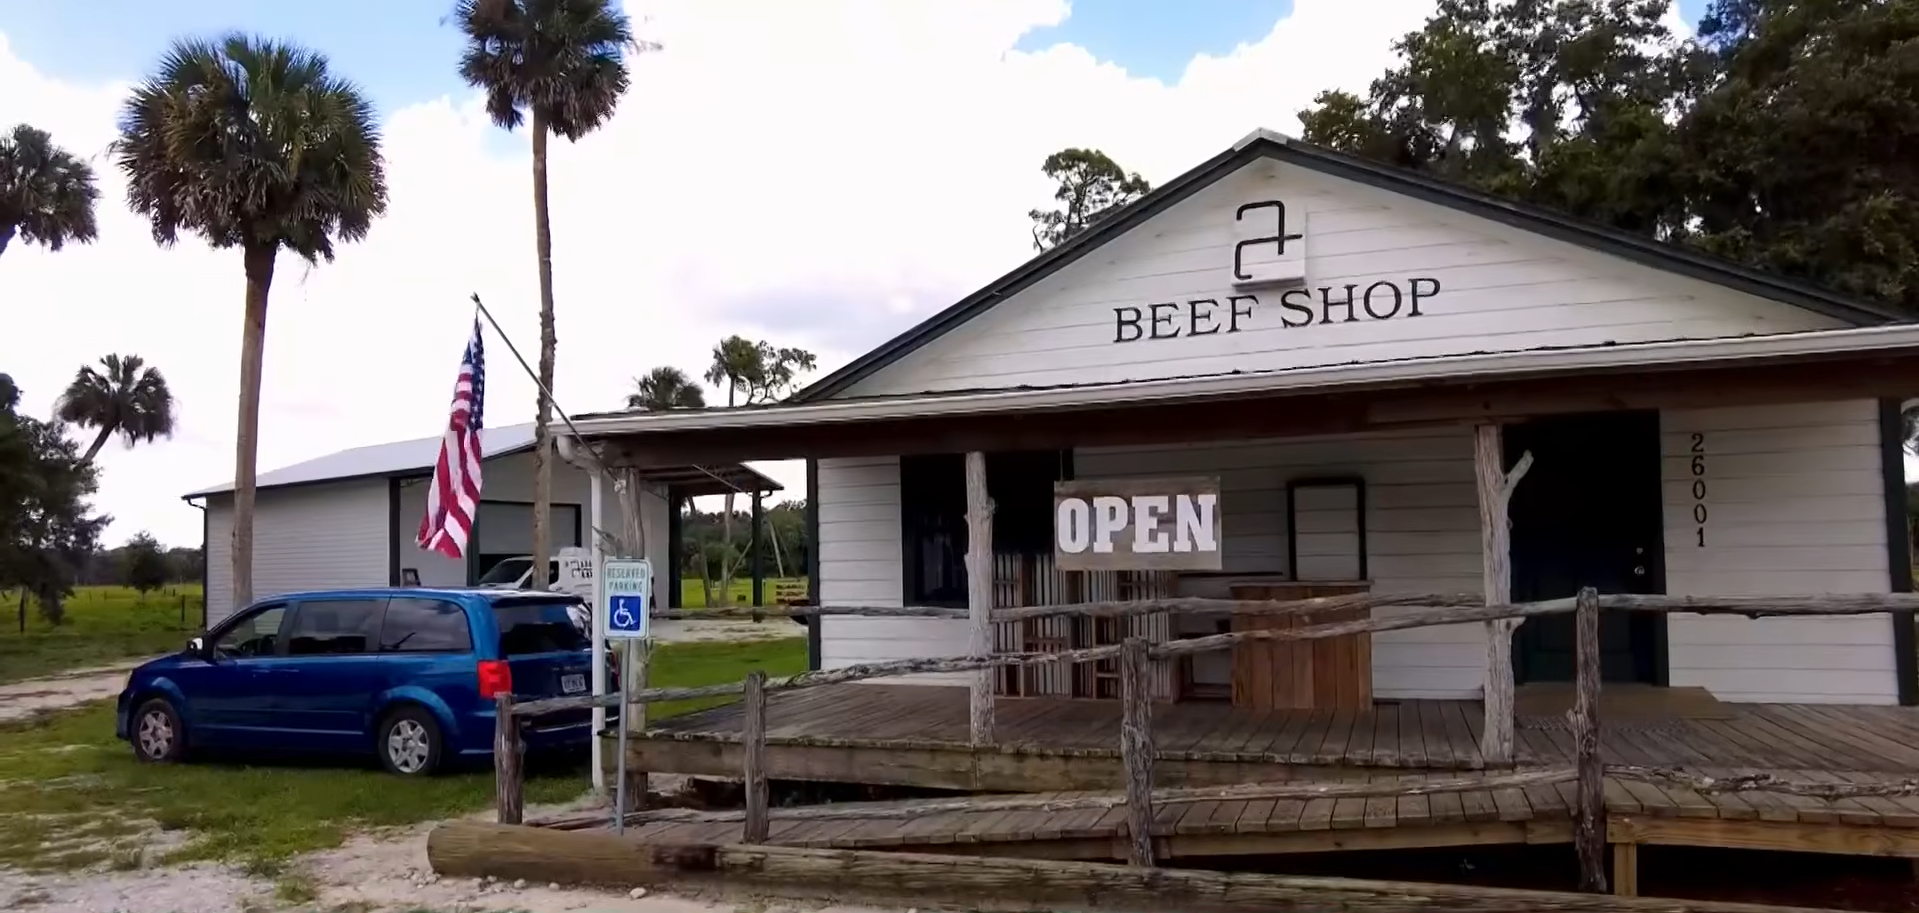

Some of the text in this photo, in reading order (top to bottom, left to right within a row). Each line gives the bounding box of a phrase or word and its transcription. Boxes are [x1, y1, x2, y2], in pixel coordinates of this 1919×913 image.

[1113, 278, 1441, 343] BEEF SHOP
[1691, 433, 1707, 547] 26001
[1057, 494, 1217, 553] OPEN
[607, 567, 646, 579] RESERVED
[609, 581, 643, 593] PARKING
